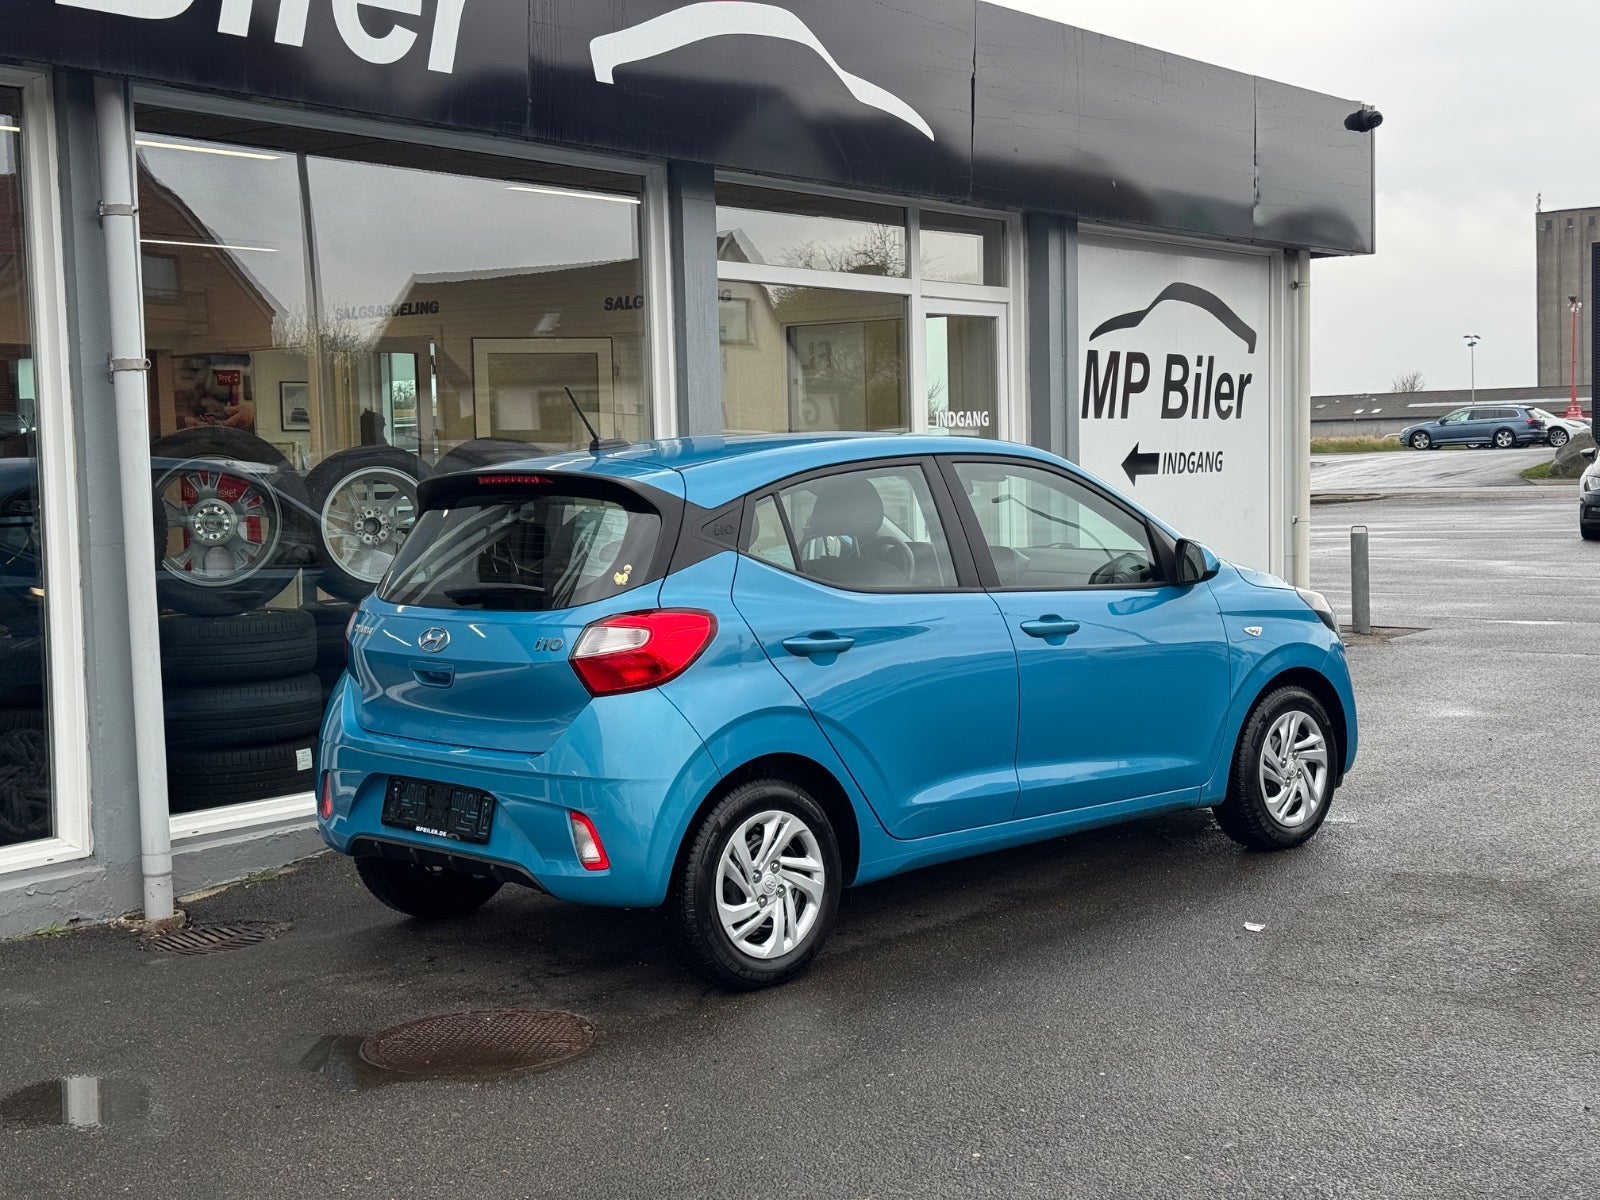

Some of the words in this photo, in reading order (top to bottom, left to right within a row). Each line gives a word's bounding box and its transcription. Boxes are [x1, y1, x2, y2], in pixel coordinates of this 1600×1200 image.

[1081, 350, 1150, 419] MP
[1160, 353, 1253, 421] Biler
[935, 410, 990, 428] INDGANG
[1162, 451, 1224, 475] INDGANG
